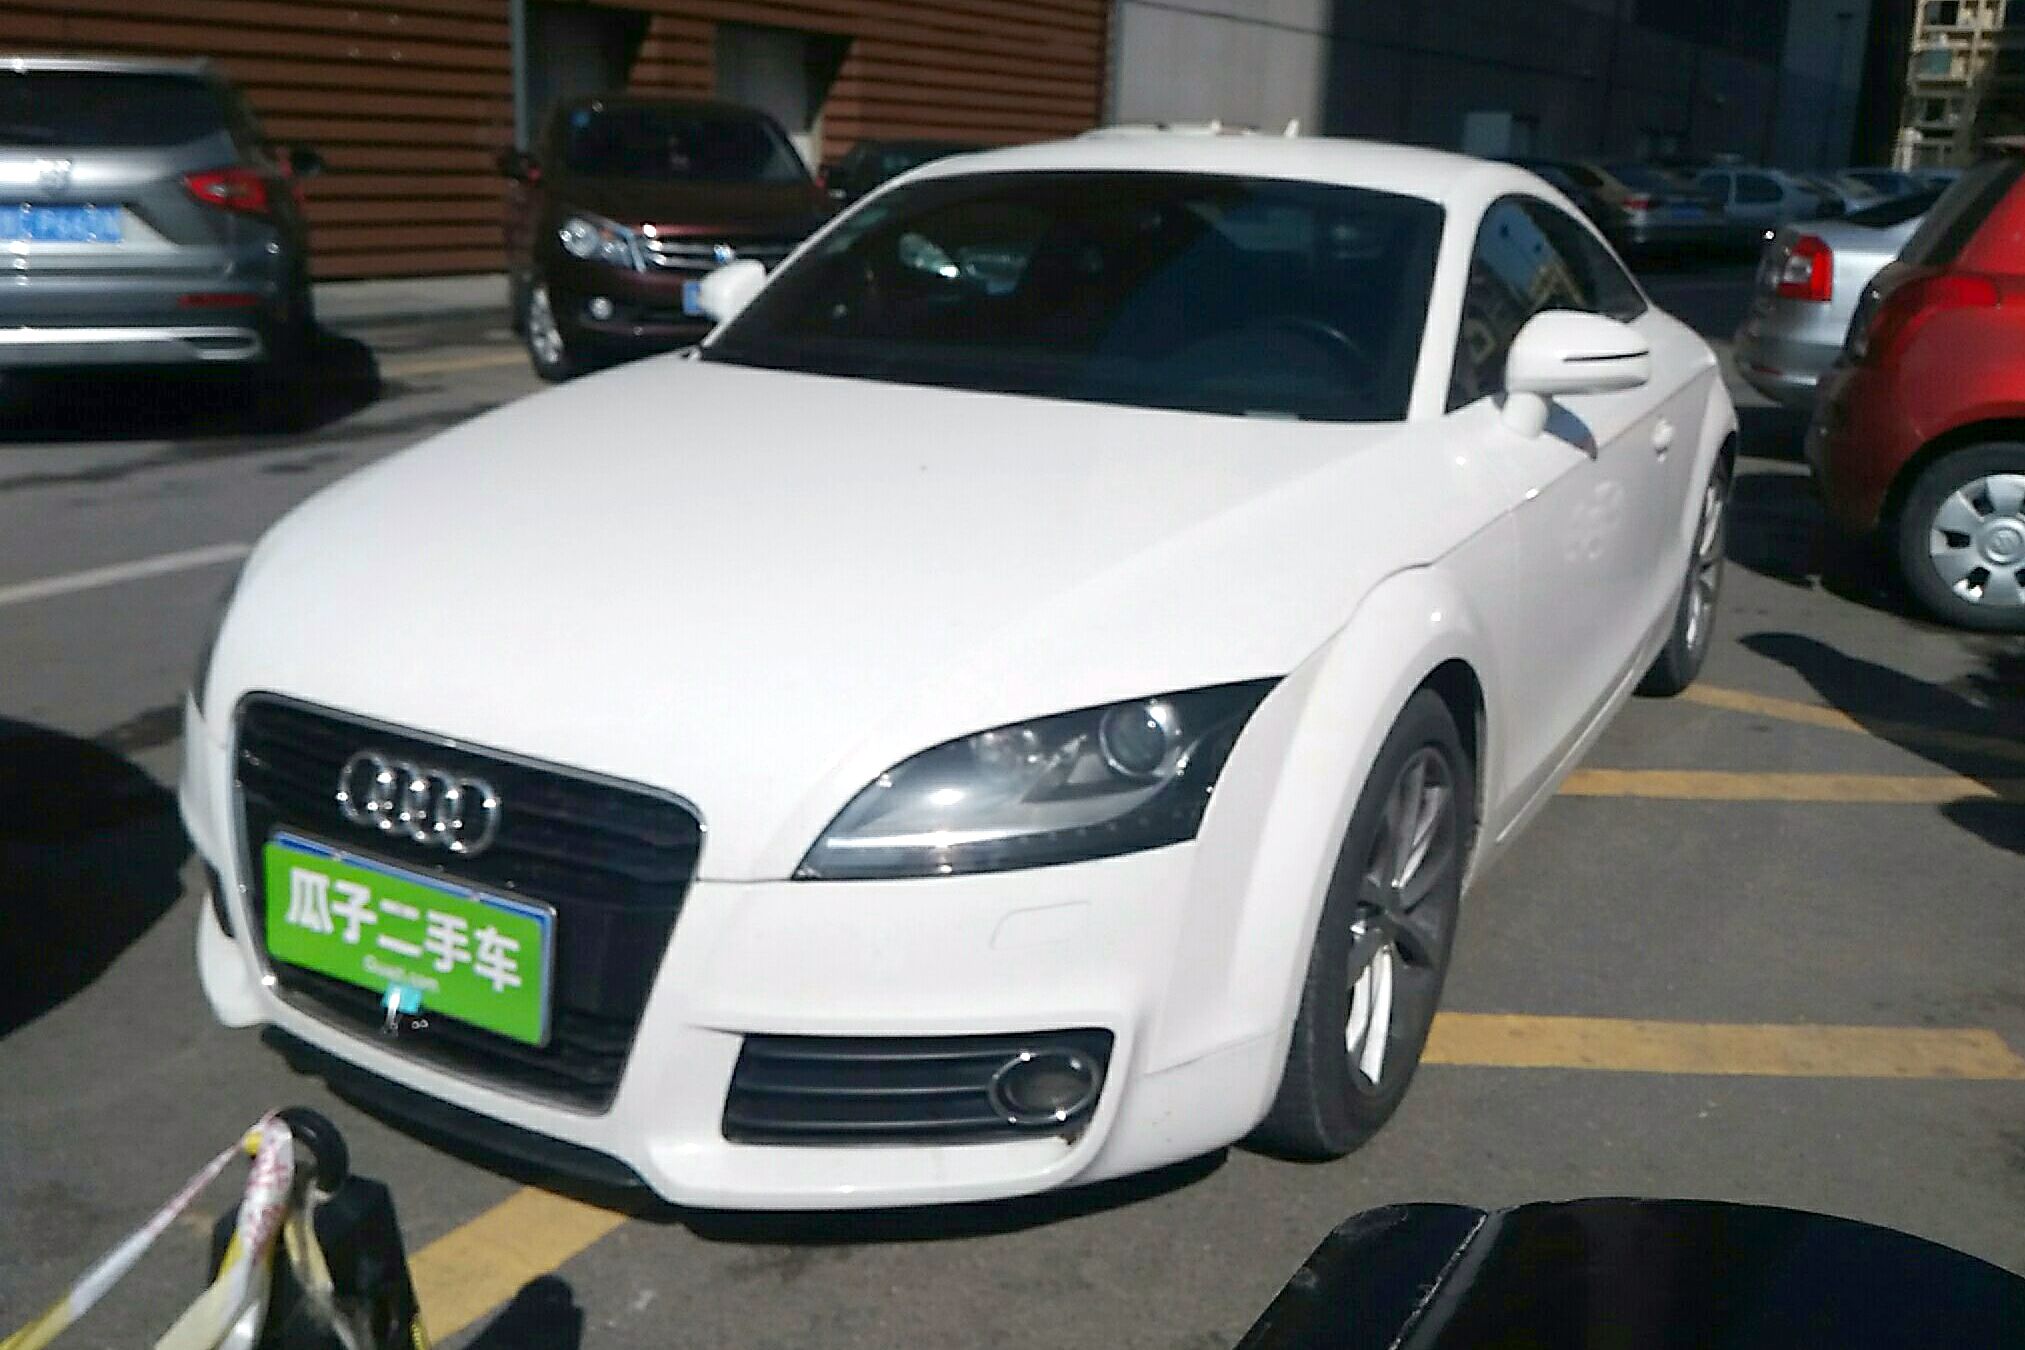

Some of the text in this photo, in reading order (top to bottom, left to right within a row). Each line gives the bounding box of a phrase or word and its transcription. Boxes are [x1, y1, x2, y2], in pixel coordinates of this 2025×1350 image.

[285, 867, 522, 992] 瓜子二手车
